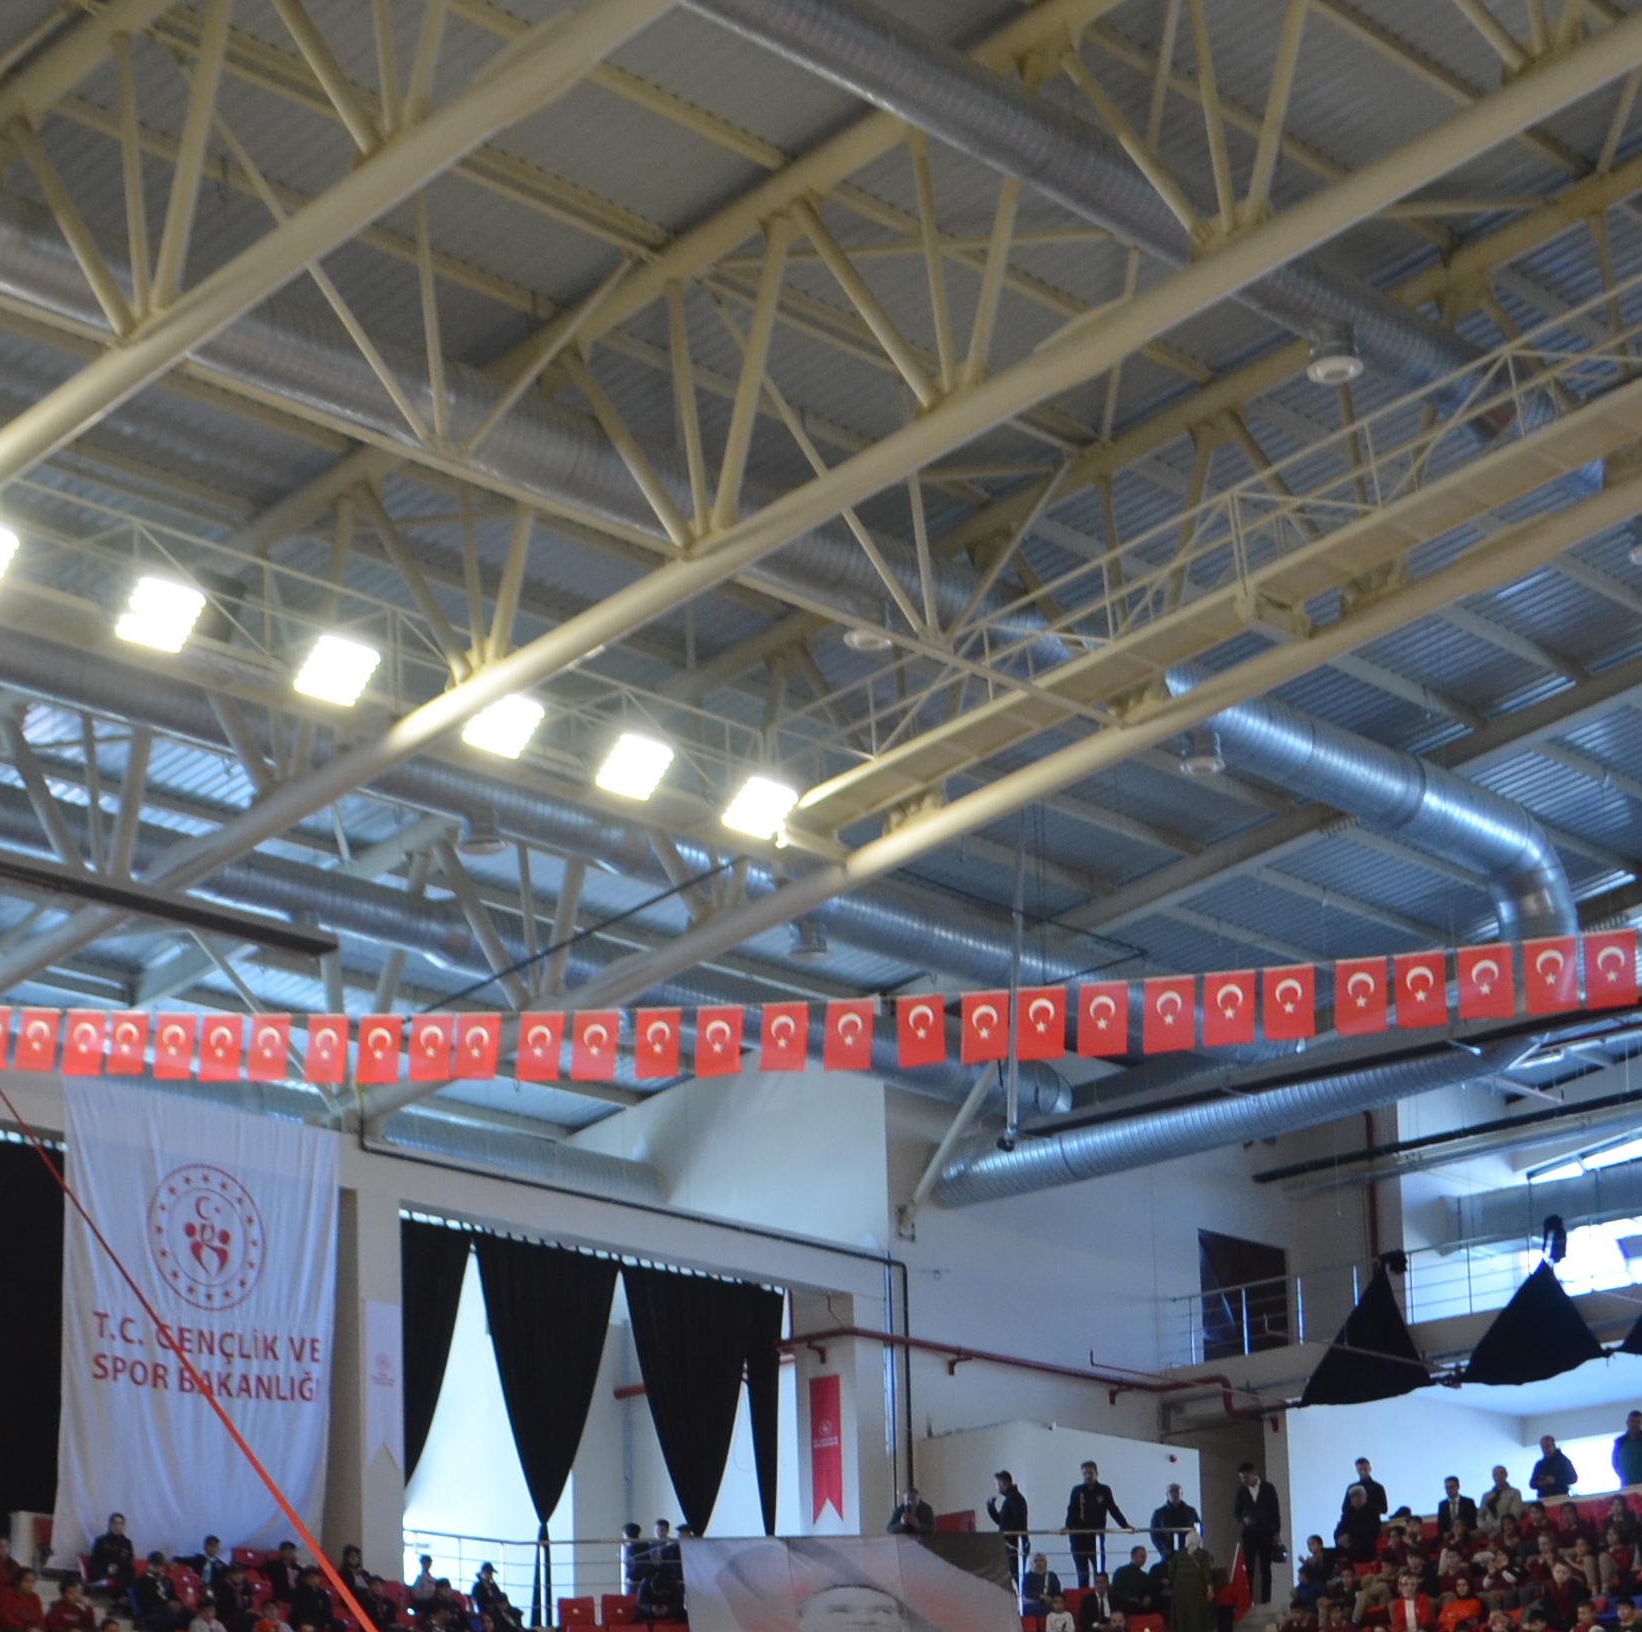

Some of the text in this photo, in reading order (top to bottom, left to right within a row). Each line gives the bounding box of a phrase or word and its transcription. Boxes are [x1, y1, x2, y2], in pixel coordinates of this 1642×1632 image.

[92, 1310, 321, 1366] T.C. GENÇLİK VE
[92, 1353, 169, 1391] SPOR
